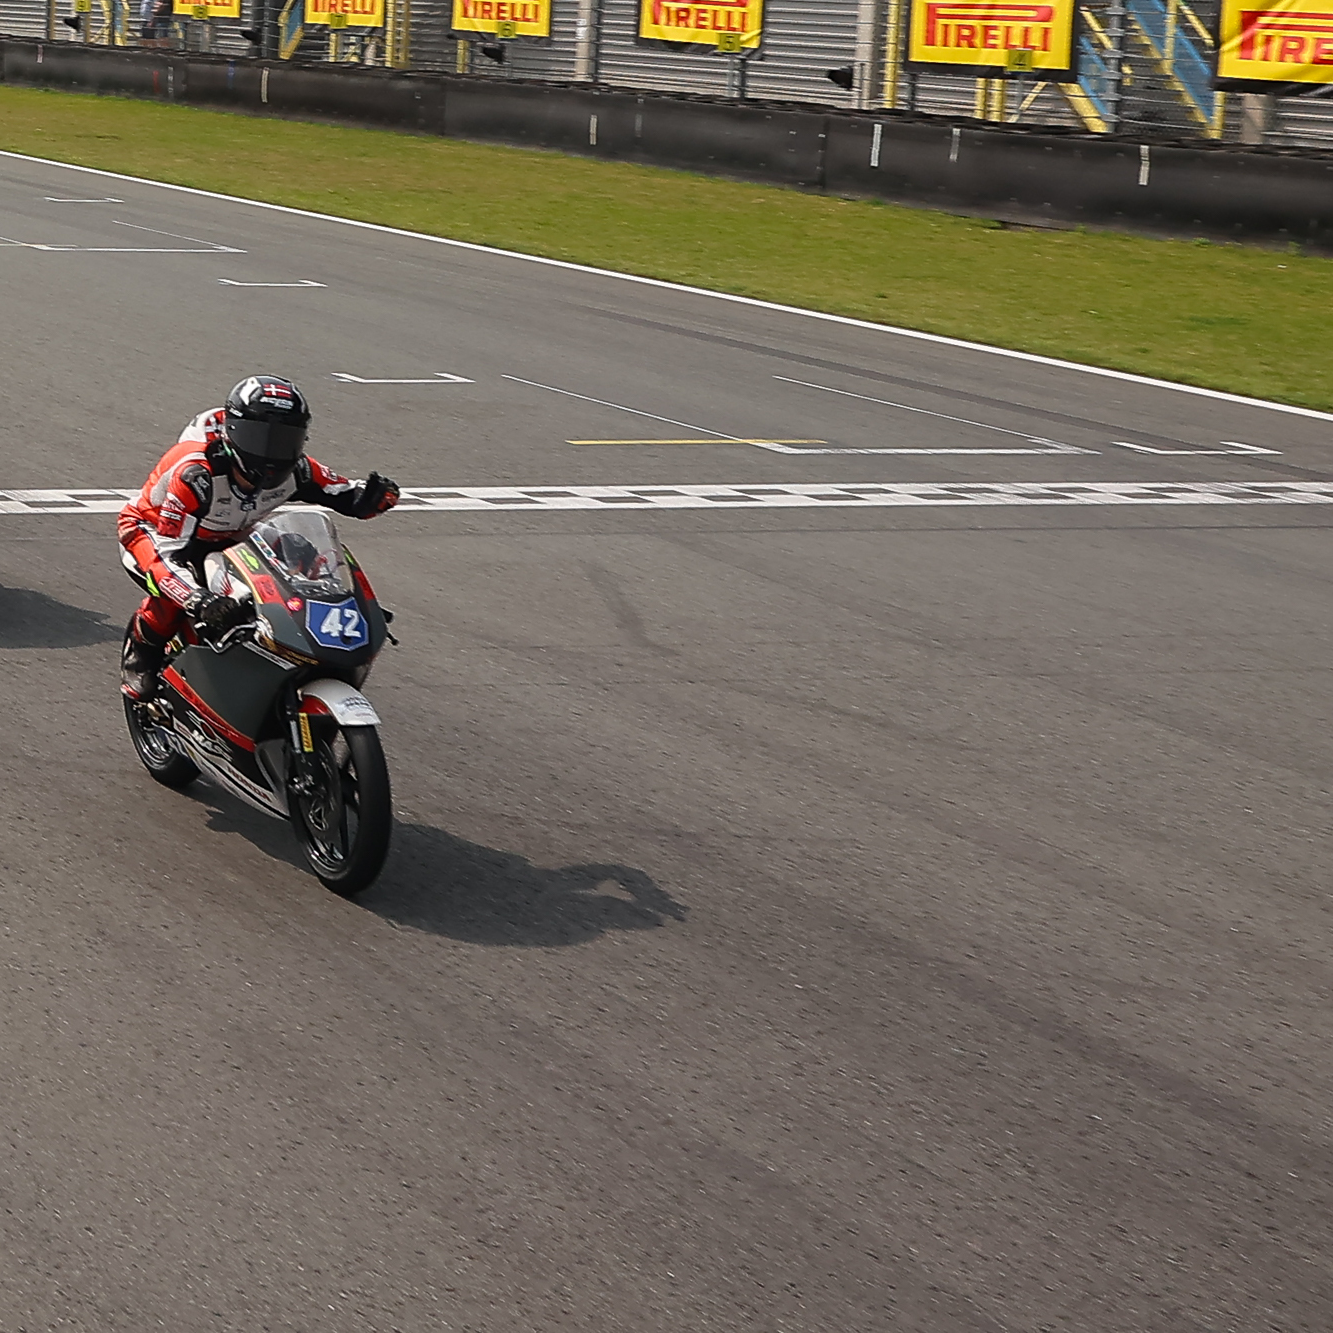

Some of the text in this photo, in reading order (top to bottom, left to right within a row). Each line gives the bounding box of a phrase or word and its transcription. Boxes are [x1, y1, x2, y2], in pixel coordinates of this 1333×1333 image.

[924, 2, 1053, 52] PIRELLI
[1239, 10, 1333, 65] PIRE
[321, 608, 362, 638] 42
